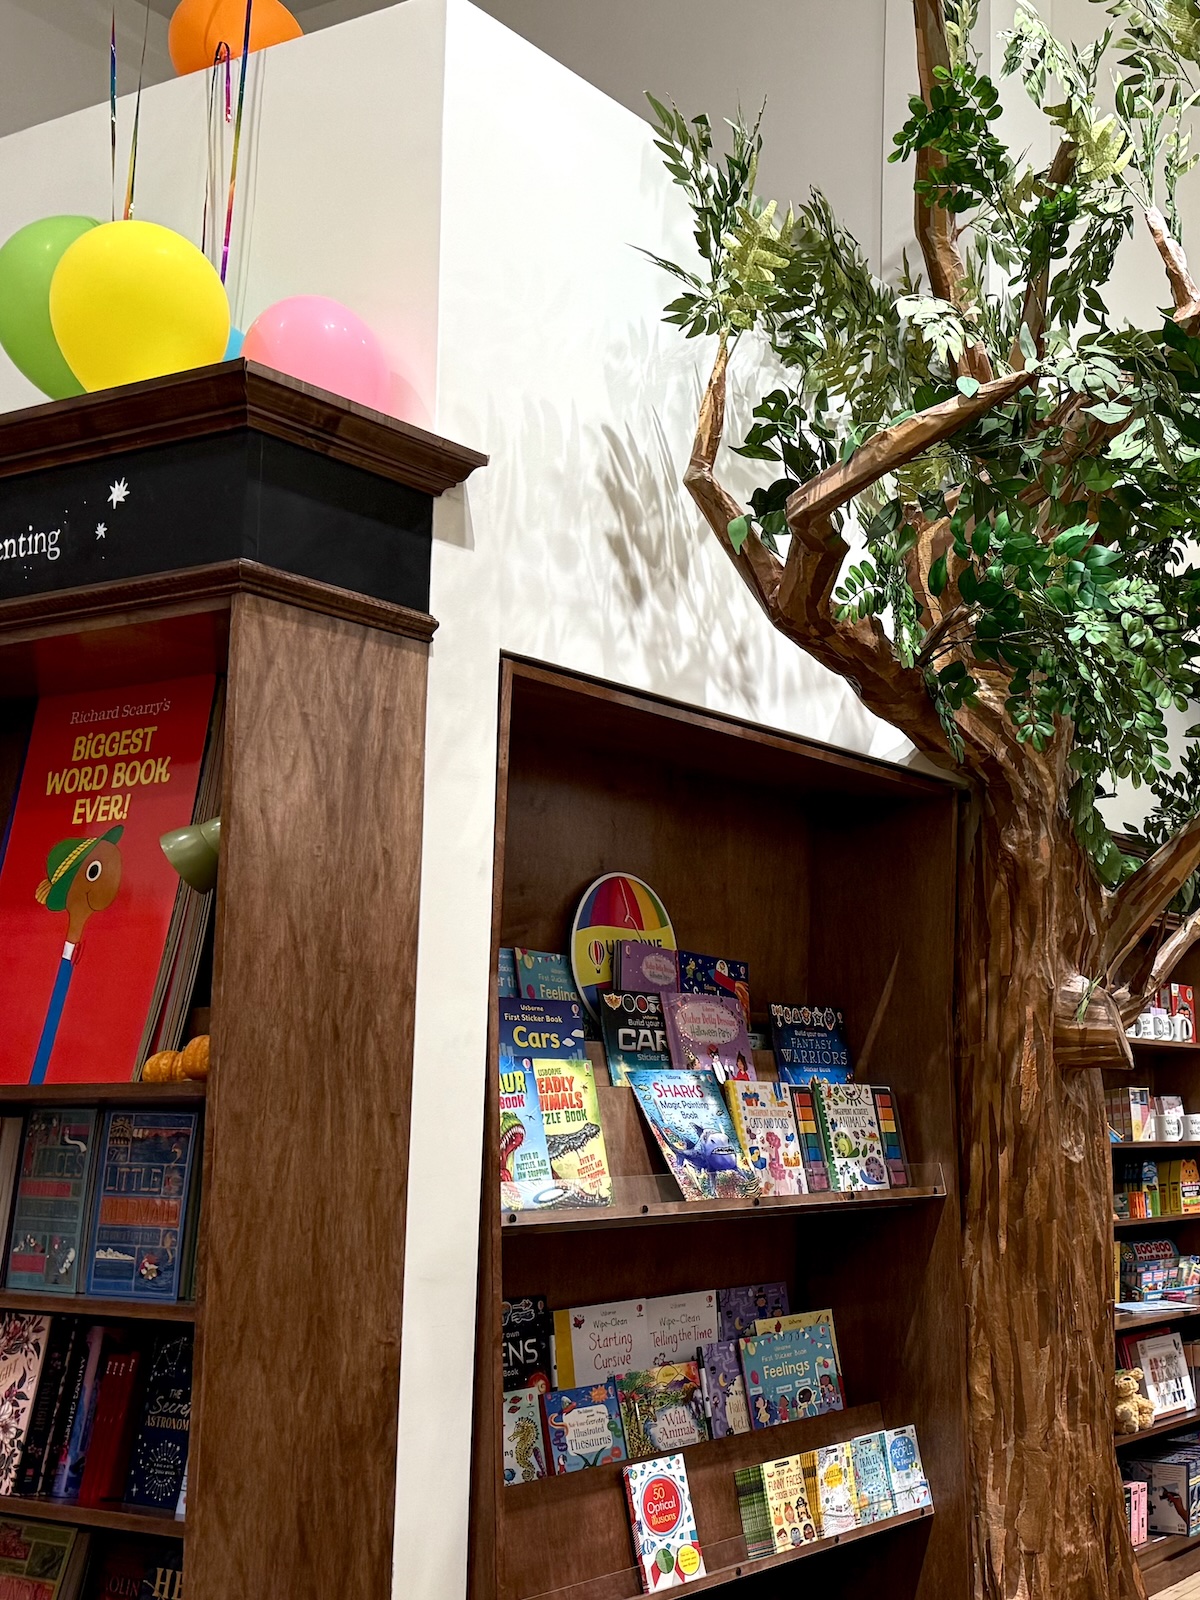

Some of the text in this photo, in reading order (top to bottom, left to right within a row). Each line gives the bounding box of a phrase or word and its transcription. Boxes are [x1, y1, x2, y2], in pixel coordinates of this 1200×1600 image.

[70, 698, 172, 725] Richard Scarry's
[46, 756, 171, 796] WORD BOOK
[72, 793, 131, 825] EVER!
[504, 1013, 563, 1024] First Sticker Book
[512, 1026, 561, 1049] Cars
[791, 1037, 832, 1050] FANTASY
[781, 1049, 848, 1065] WARRIORS
[652, 1082, 704, 1099] SHARKS
[660, 1101, 710, 1111] Magic Painting
[566, 1109, 588, 1123] BOOK
[680, 1111, 699, 1120] Book
[839, 1116, 868, 1129] ANIMALS
[763, 1119, 775, 1129] AND
[775, 1118, 789, 1130] DOGS
[105, 1166, 162, 1192] LITTLE
[593, 1317, 628, 1330] Wipe-Clean
[659, 1314, 701, 1328] Wipe-Clean
[589, 1332, 634, 1352] Starting
[650, 1326, 713, 1352] Telling the Time
[594, 1353, 632, 1371] Cursive
[762, 1354, 774, 1362] First
[763, 1359, 810, 1380] Feelings
[168, 1388, 183, 1399] THE
[662, 1410, 687, 1427] Wild
[658, 1424, 696, 1443] Animals
[570, 1435, 612, 1451] Thesaurus
[859, 1454, 878, 1469] TRAVEL
[768, 1473, 802, 1492] FUNNY FACES
[652, 1486, 666, 1501] 50
[647, 1500, 677, 1515] Optical
[651, 1514, 677, 1526] illusions
